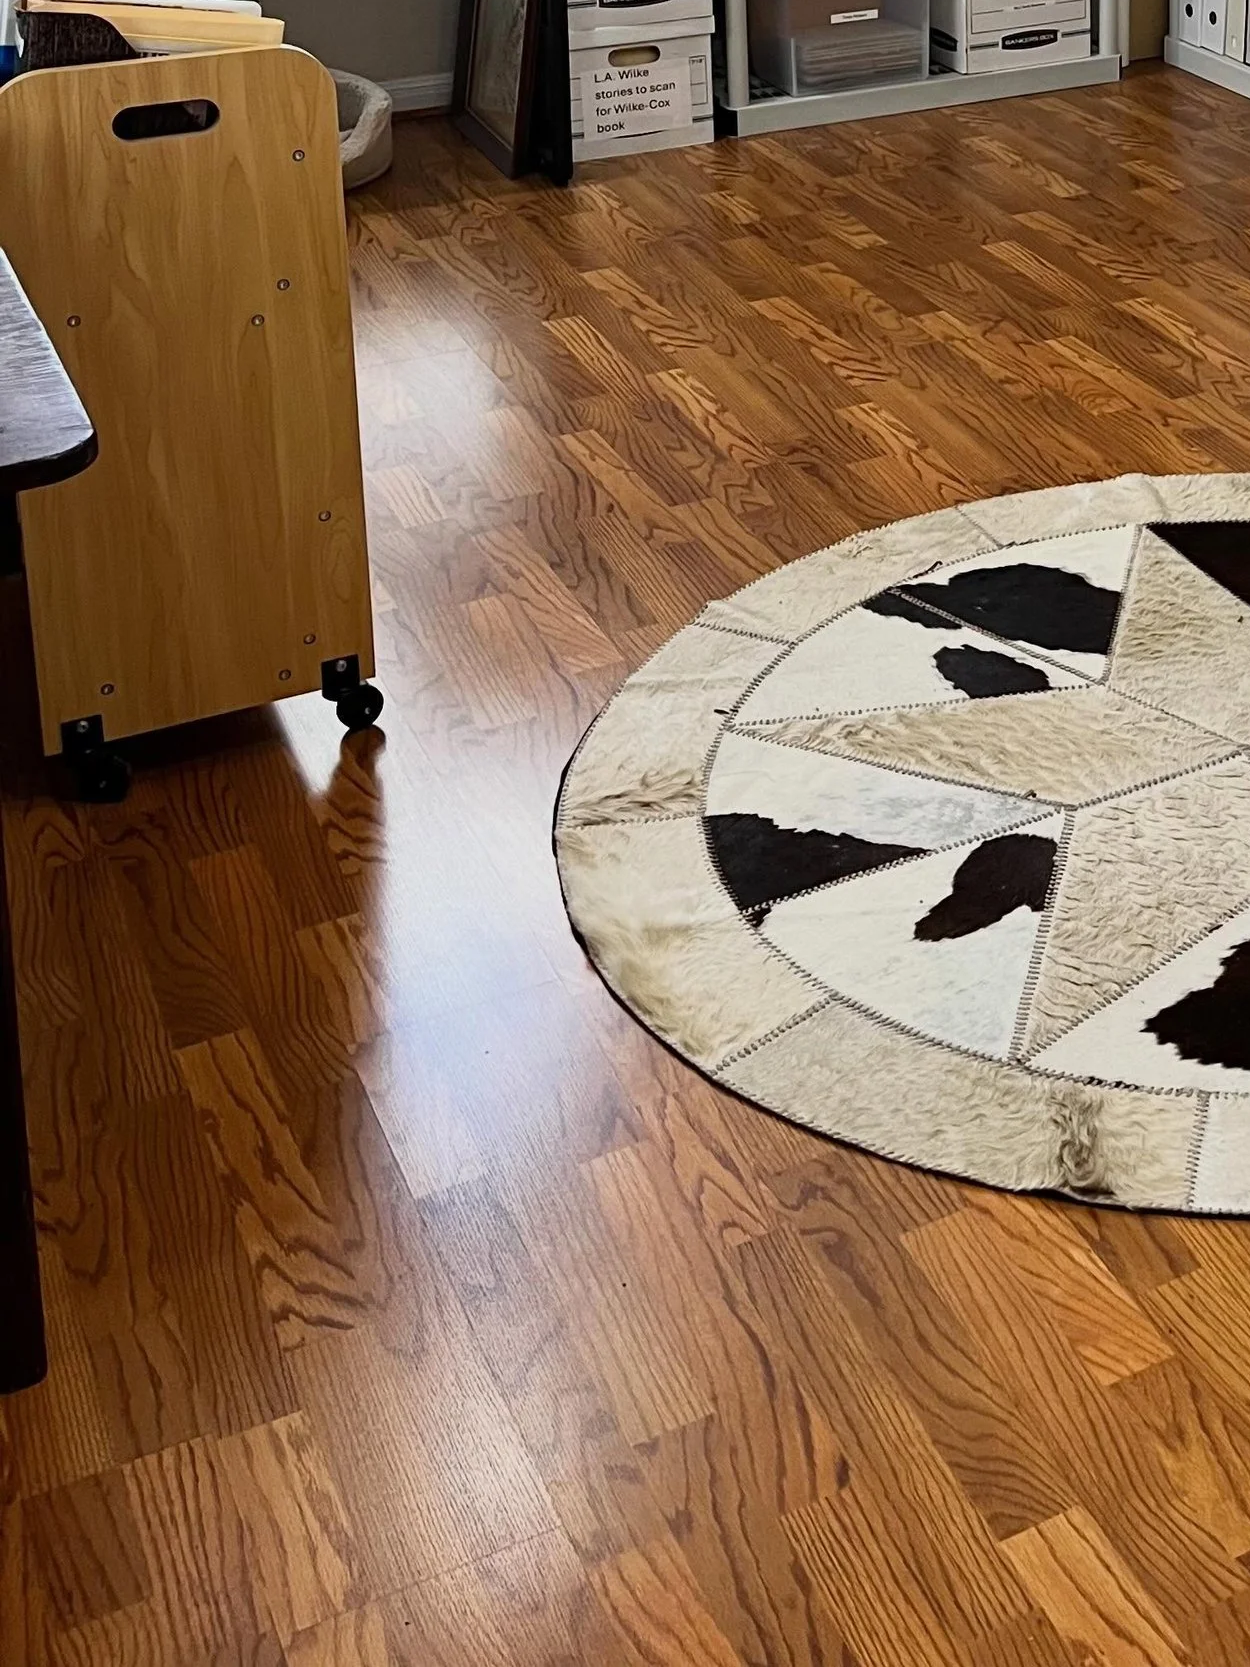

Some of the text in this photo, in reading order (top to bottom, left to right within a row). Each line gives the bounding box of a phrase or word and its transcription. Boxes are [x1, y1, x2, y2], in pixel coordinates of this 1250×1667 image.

[594, 69, 650, 83] L.A. Wilke
[595, 82, 676, 100] stories to scan
[596, 99, 671, 117] for Wilke-Cox
[597, 121, 626, 134] book
